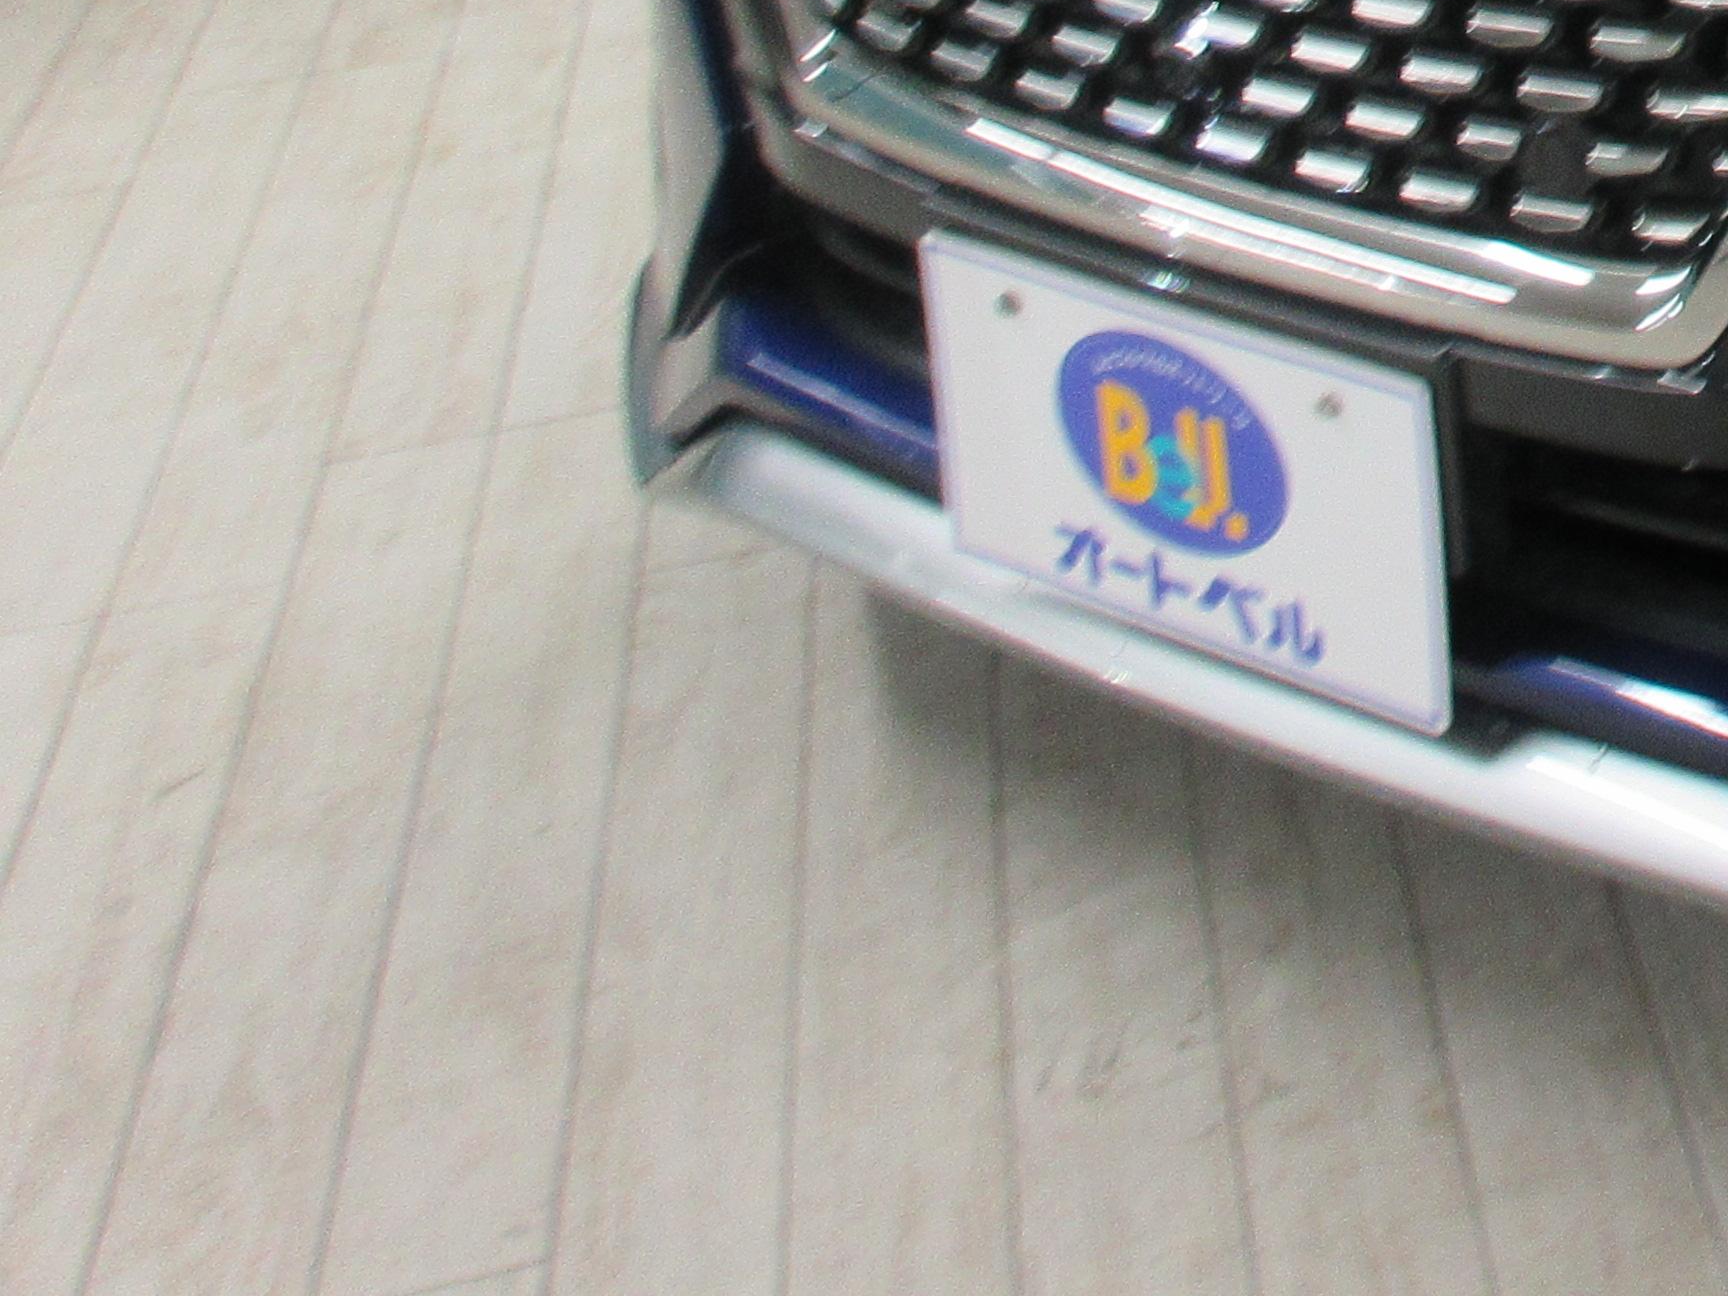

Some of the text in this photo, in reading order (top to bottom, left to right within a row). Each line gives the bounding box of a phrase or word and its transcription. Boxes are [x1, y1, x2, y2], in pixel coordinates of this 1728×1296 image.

[1054, 522, 1327, 667] オートベル
